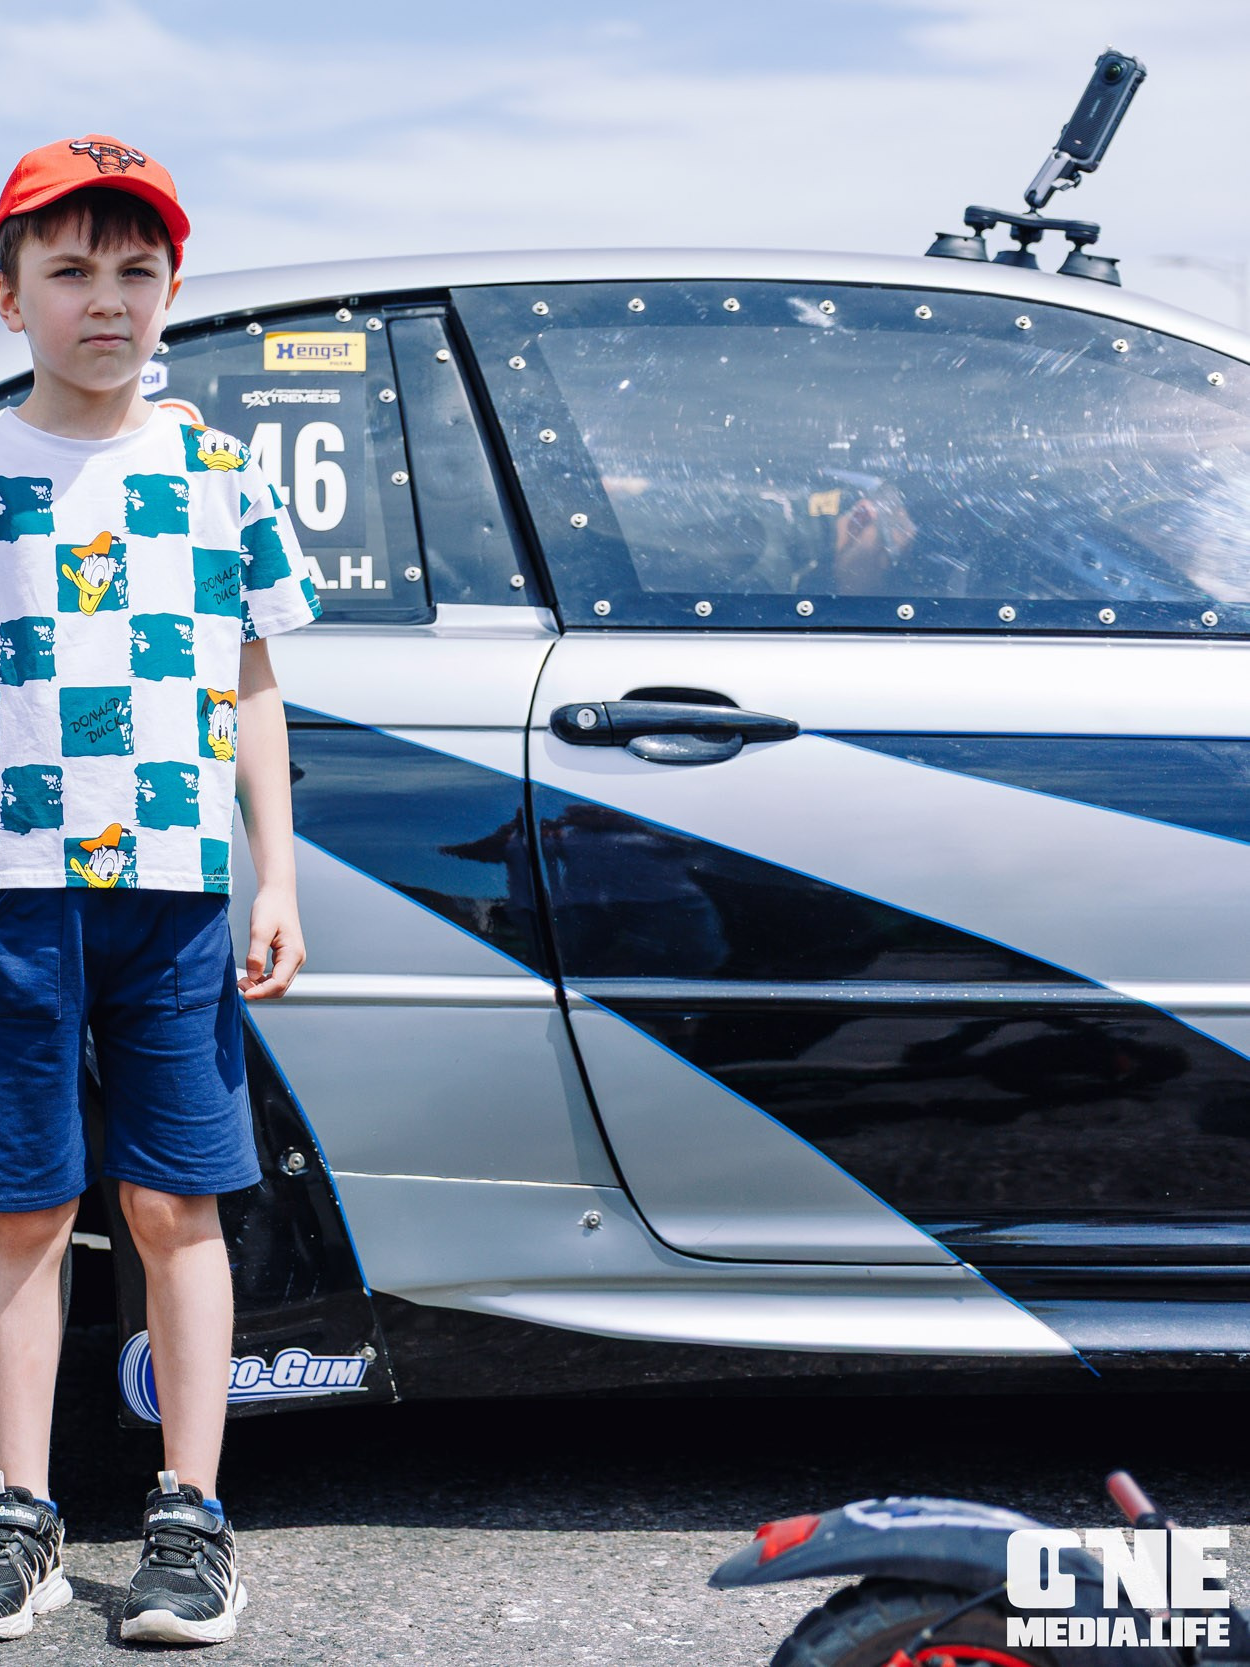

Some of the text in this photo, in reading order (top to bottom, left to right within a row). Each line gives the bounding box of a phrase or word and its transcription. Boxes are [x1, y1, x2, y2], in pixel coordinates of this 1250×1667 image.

[276, 342, 350, 359] Hengst
[249, 421, 347, 532] 46
[69, 697, 121, 733] DONALD
[85, 715, 124, 743] DUCK
